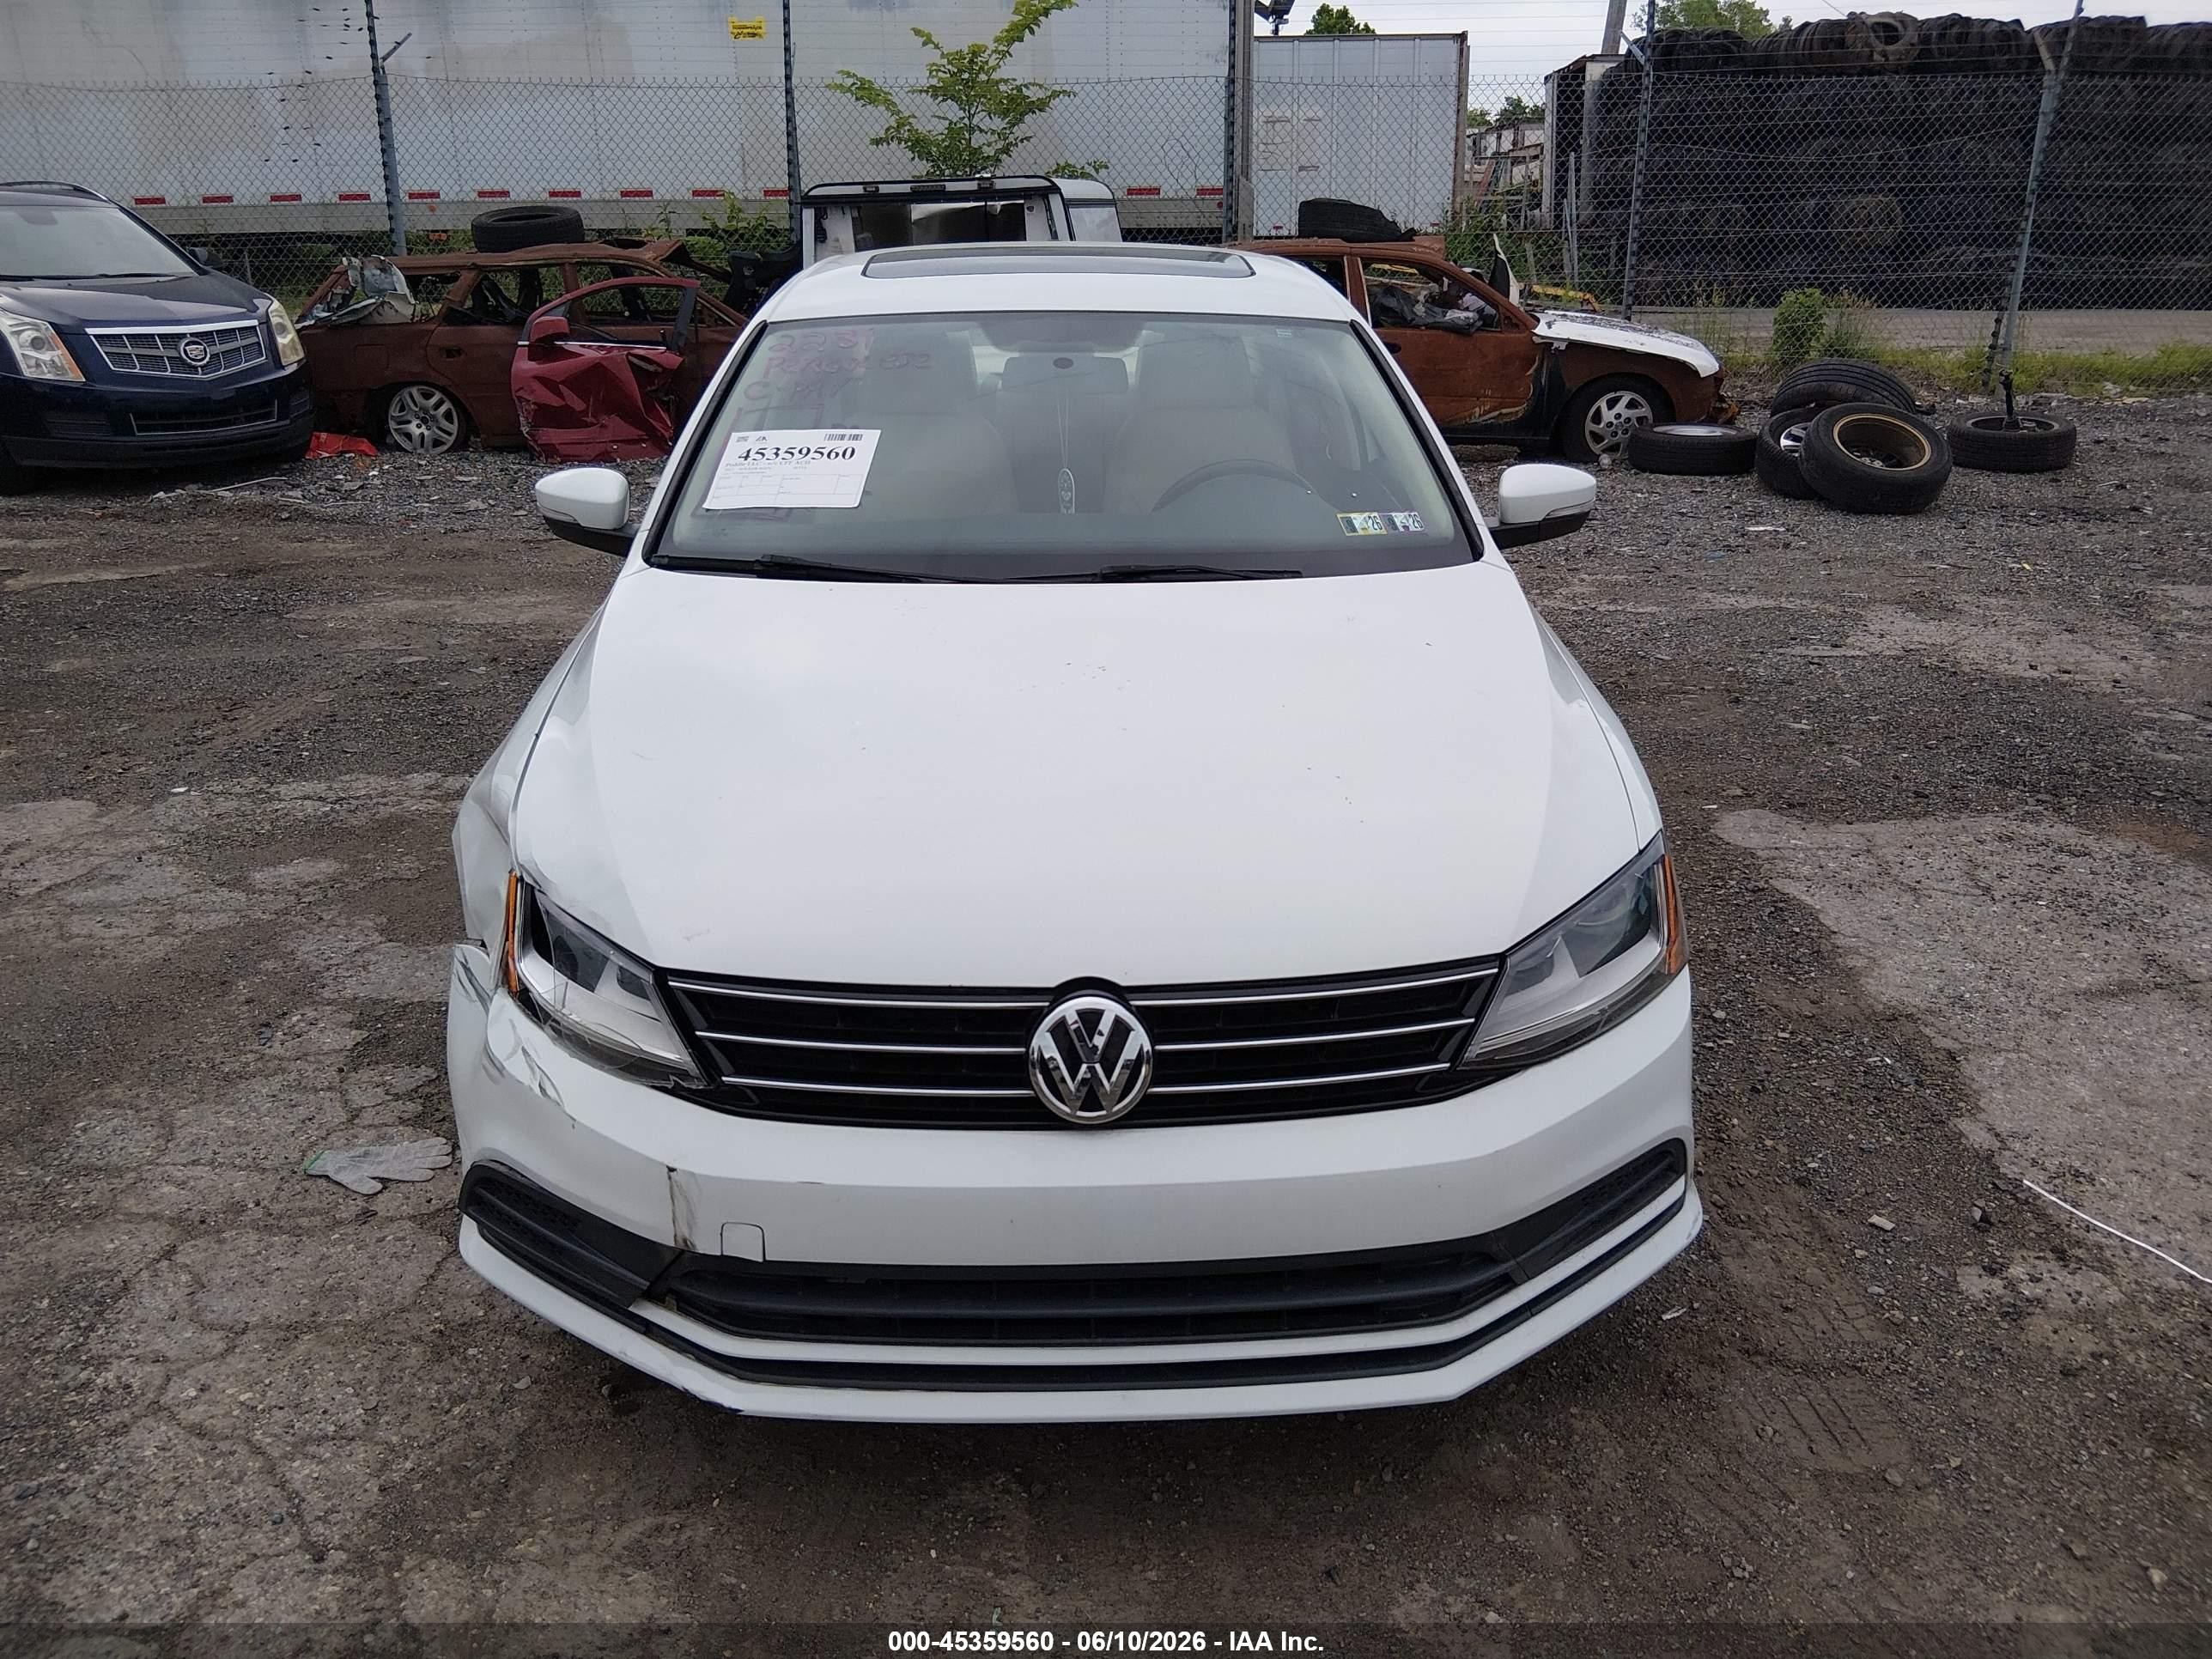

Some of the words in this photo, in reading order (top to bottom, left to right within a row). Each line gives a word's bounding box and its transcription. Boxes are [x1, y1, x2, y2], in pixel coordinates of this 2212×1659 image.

[738, 446, 856, 462] 45359560
[1368, 515, 1383, 531] 26
[1409, 514, 1424, 529] 26
[1033, 1002, 1148, 1119] VW
